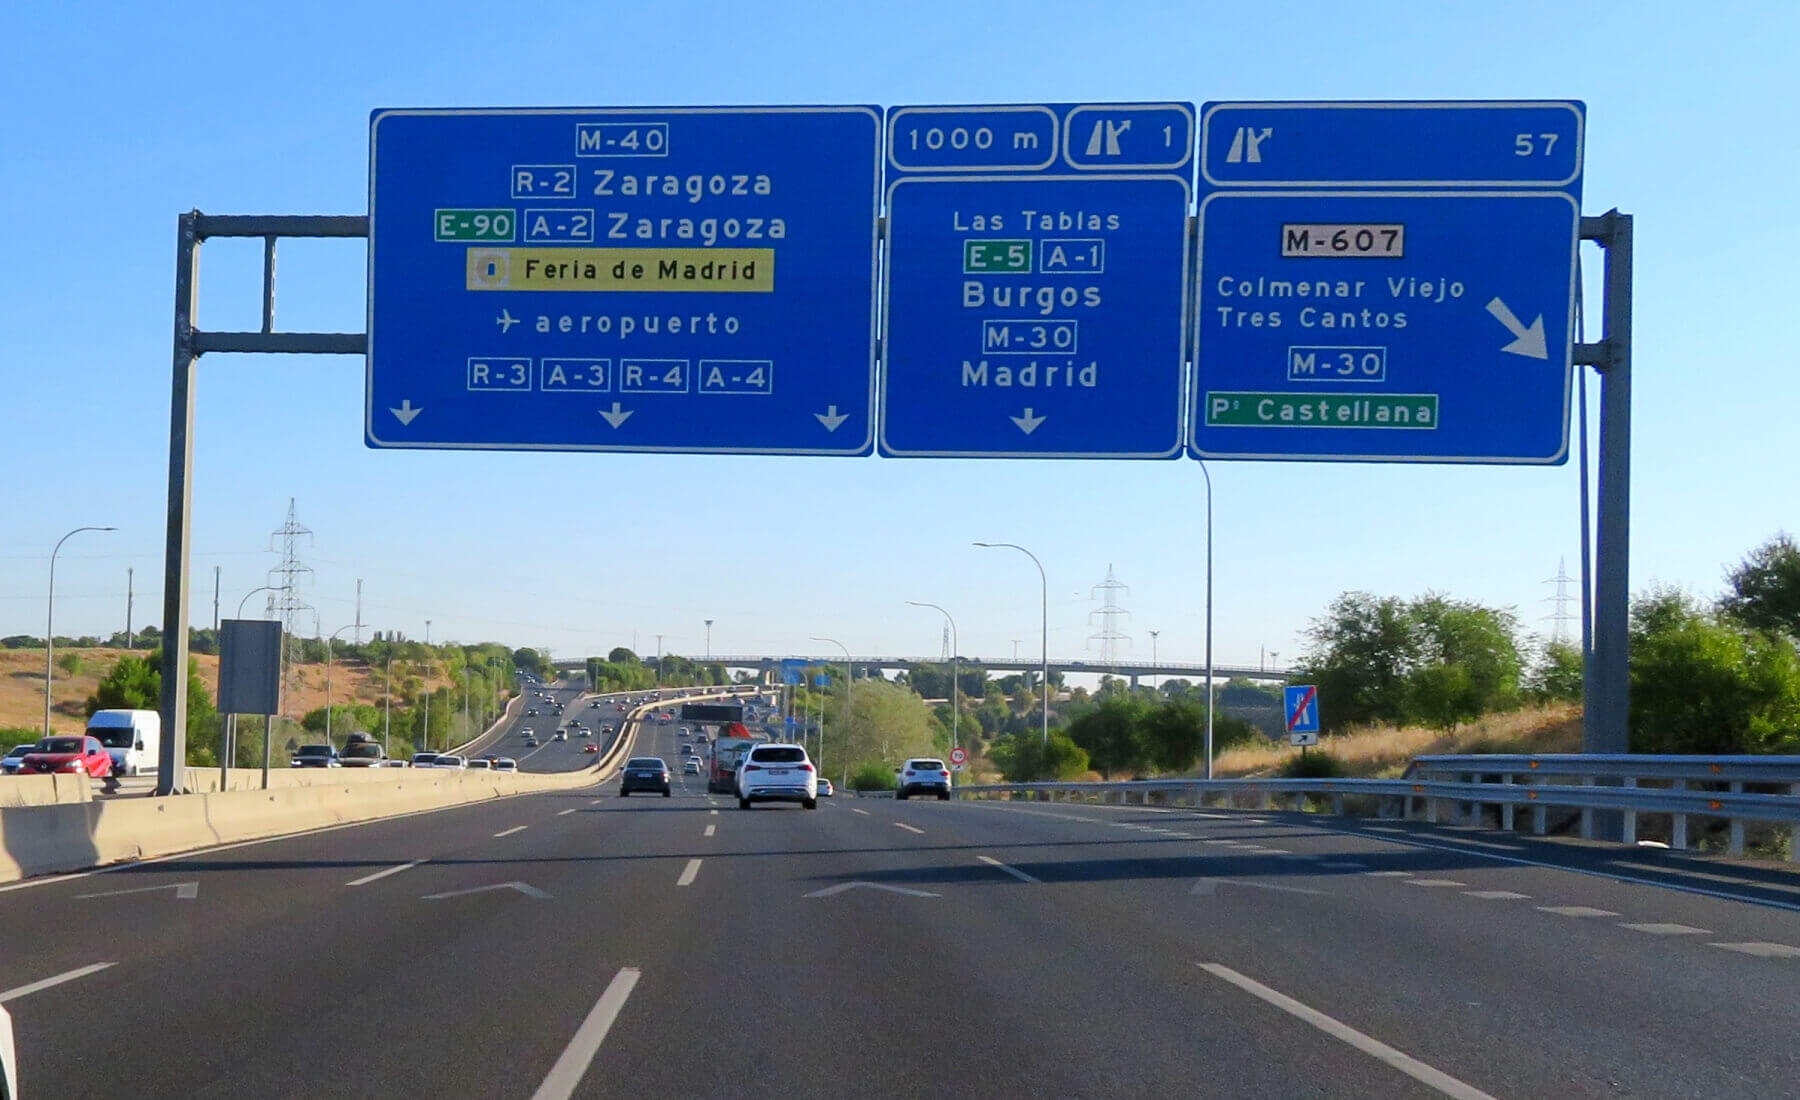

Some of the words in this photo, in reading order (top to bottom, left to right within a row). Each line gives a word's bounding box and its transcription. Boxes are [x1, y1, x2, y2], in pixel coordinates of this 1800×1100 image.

[579, 128, 664, 151] M-40
[909, 127, 993, 151] 1000
[1013, 132, 1038, 149] m
[1163, 125, 1172, 148] 1
[1514, 133, 1559, 157] 57
[517, 171, 571, 193] R-2
[593, 169, 771, 204] Zaragoza
[440, 214, 510, 237] E-90
[531, 215, 588, 237] A-2
[607, 212, 786, 246] Zaragoza
[953, 210, 1004, 232] Las
[1021, 210, 1120, 231] Tablas
[1286, 229, 1399, 252] M-607
[970, 245, 1025, 268] E-5
[1047, 245, 1098, 268] A-1
[525, 258, 597, 280] Feria
[611, 260, 644, 280] de
[658, 259, 755, 281] Madrid
[963, 280, 1101, 316] Burgos
[1218, 276, 1366, 298] Colmenar
[1387, 276, 1465, 303] Viejo
[535, 312, 739, 340] aeropuerto
[1217, 306, 1282, 328] Tres
[1299, 307, 1407, 329] Cantos
[986, 326, 1072, 348] M-30
[962, 360, 1097, 388] Madrid
[1292, 352, 1380, 375] M-30
[473, 363, 526, 385] R-3
[548, 364, 604, 386] A-3
[626, 365, 683, 387] R-4
[705, 366, 766, 388] A-4
[1257, 399, 1432, 422] Castellana
